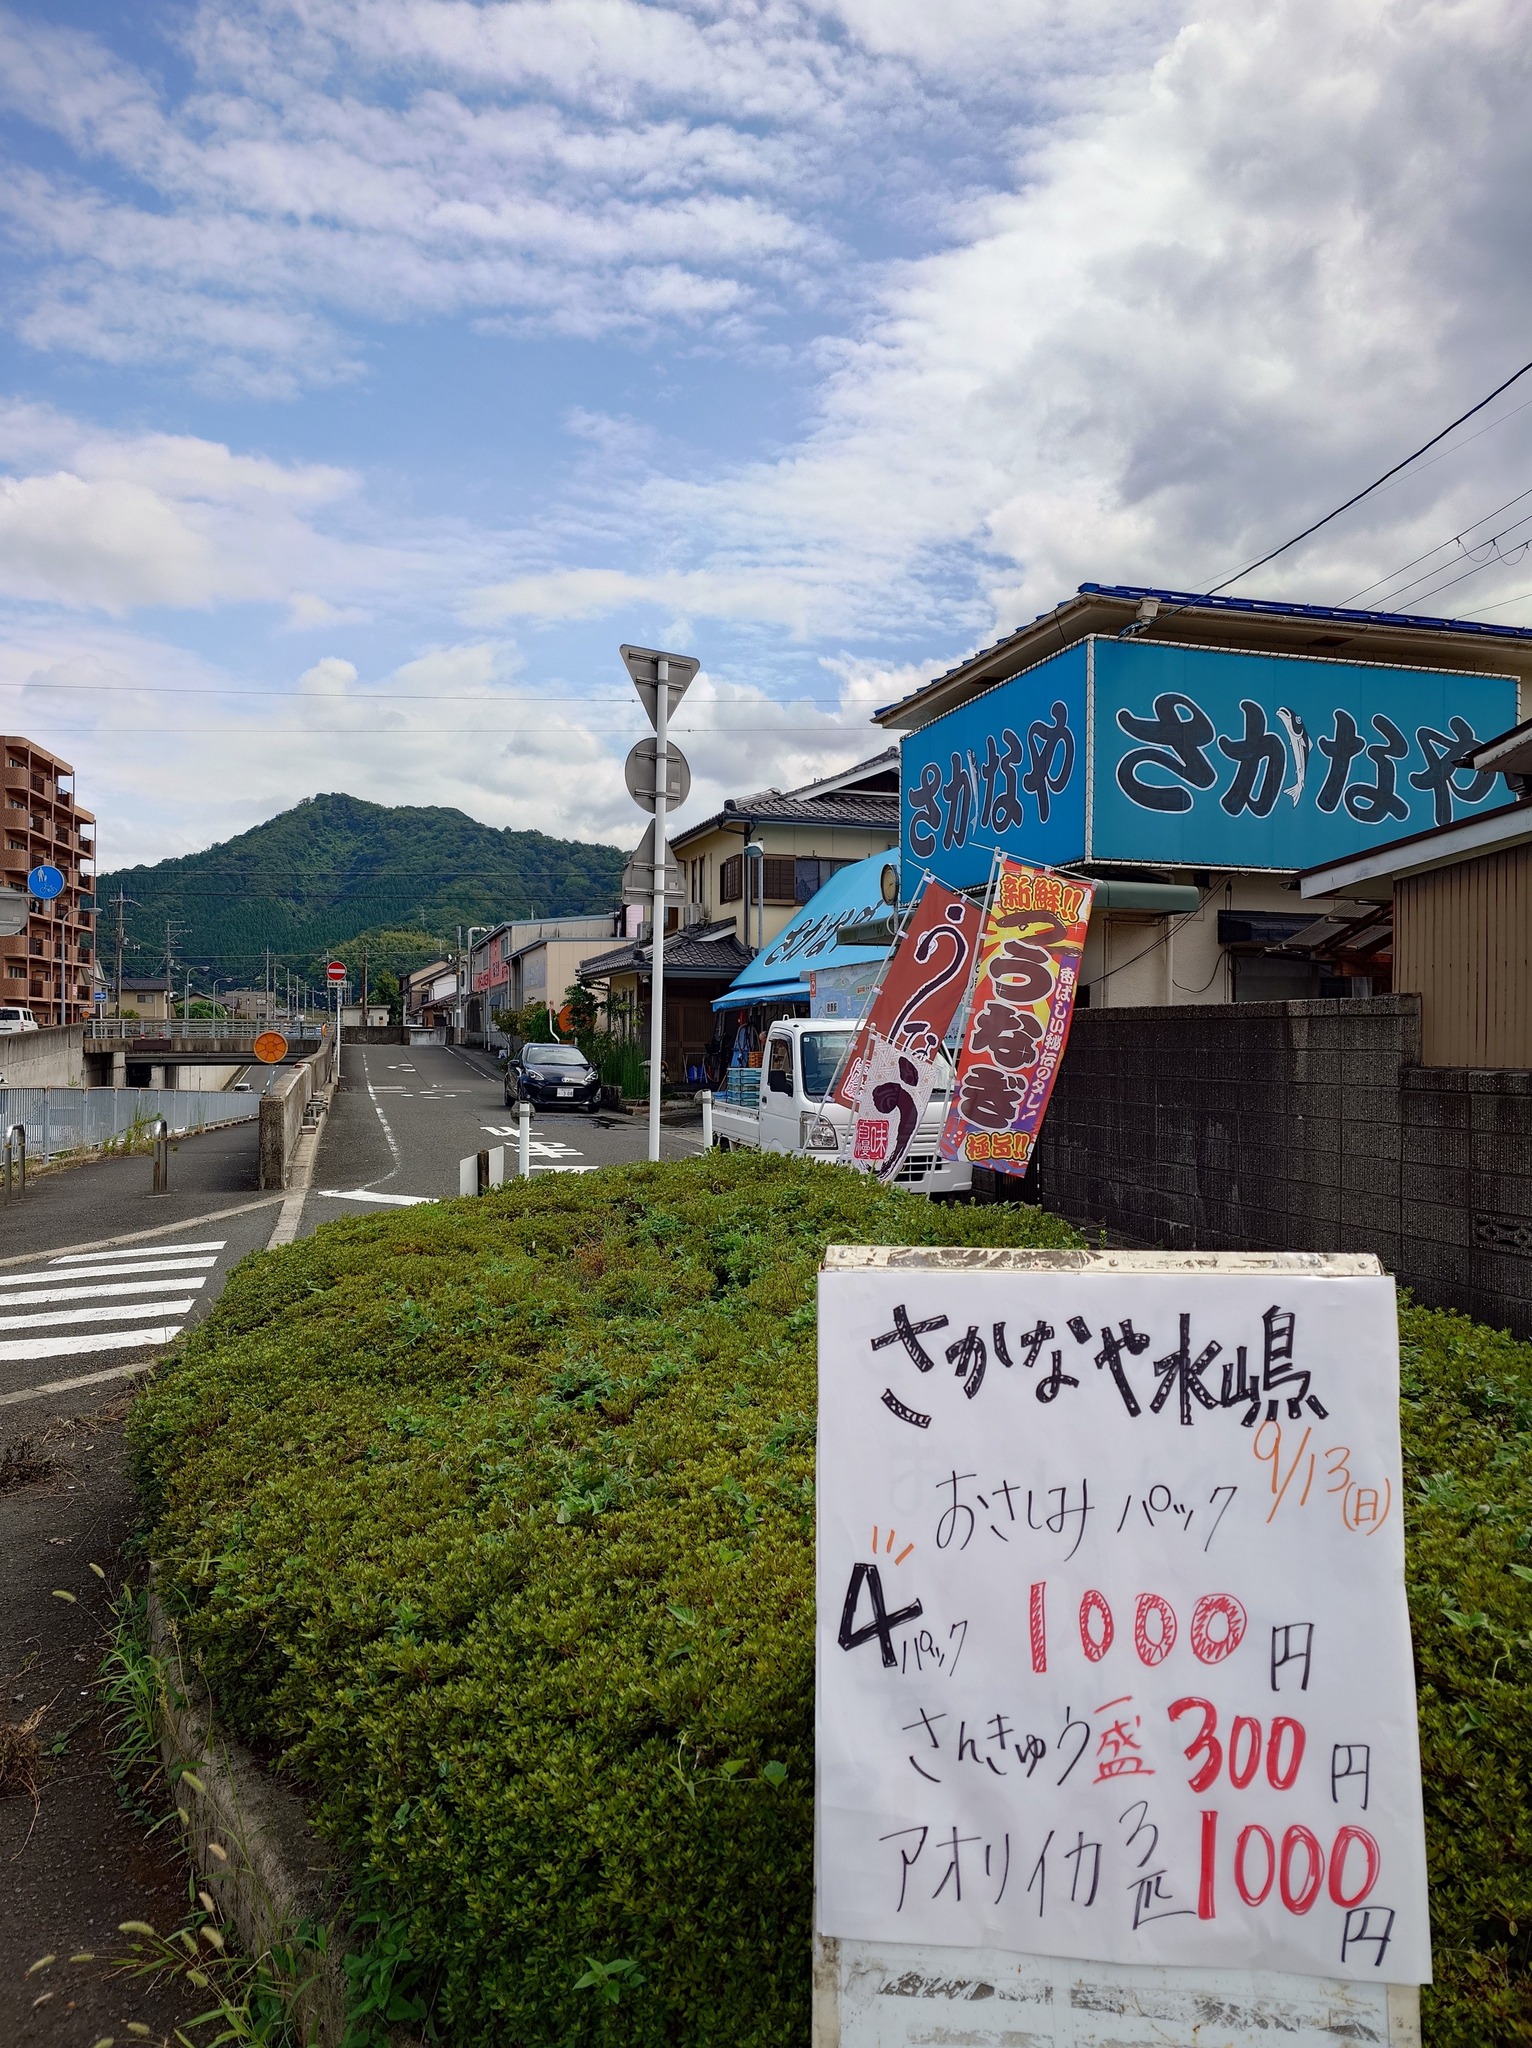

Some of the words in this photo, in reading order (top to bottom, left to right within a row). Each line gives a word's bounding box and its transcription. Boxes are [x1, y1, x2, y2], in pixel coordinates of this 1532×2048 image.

[907, 699, 1076, 858] さかなや
[1115, 691, 1499, 826] さかなや
[958, 937, 1056, 1131] うなぎ
